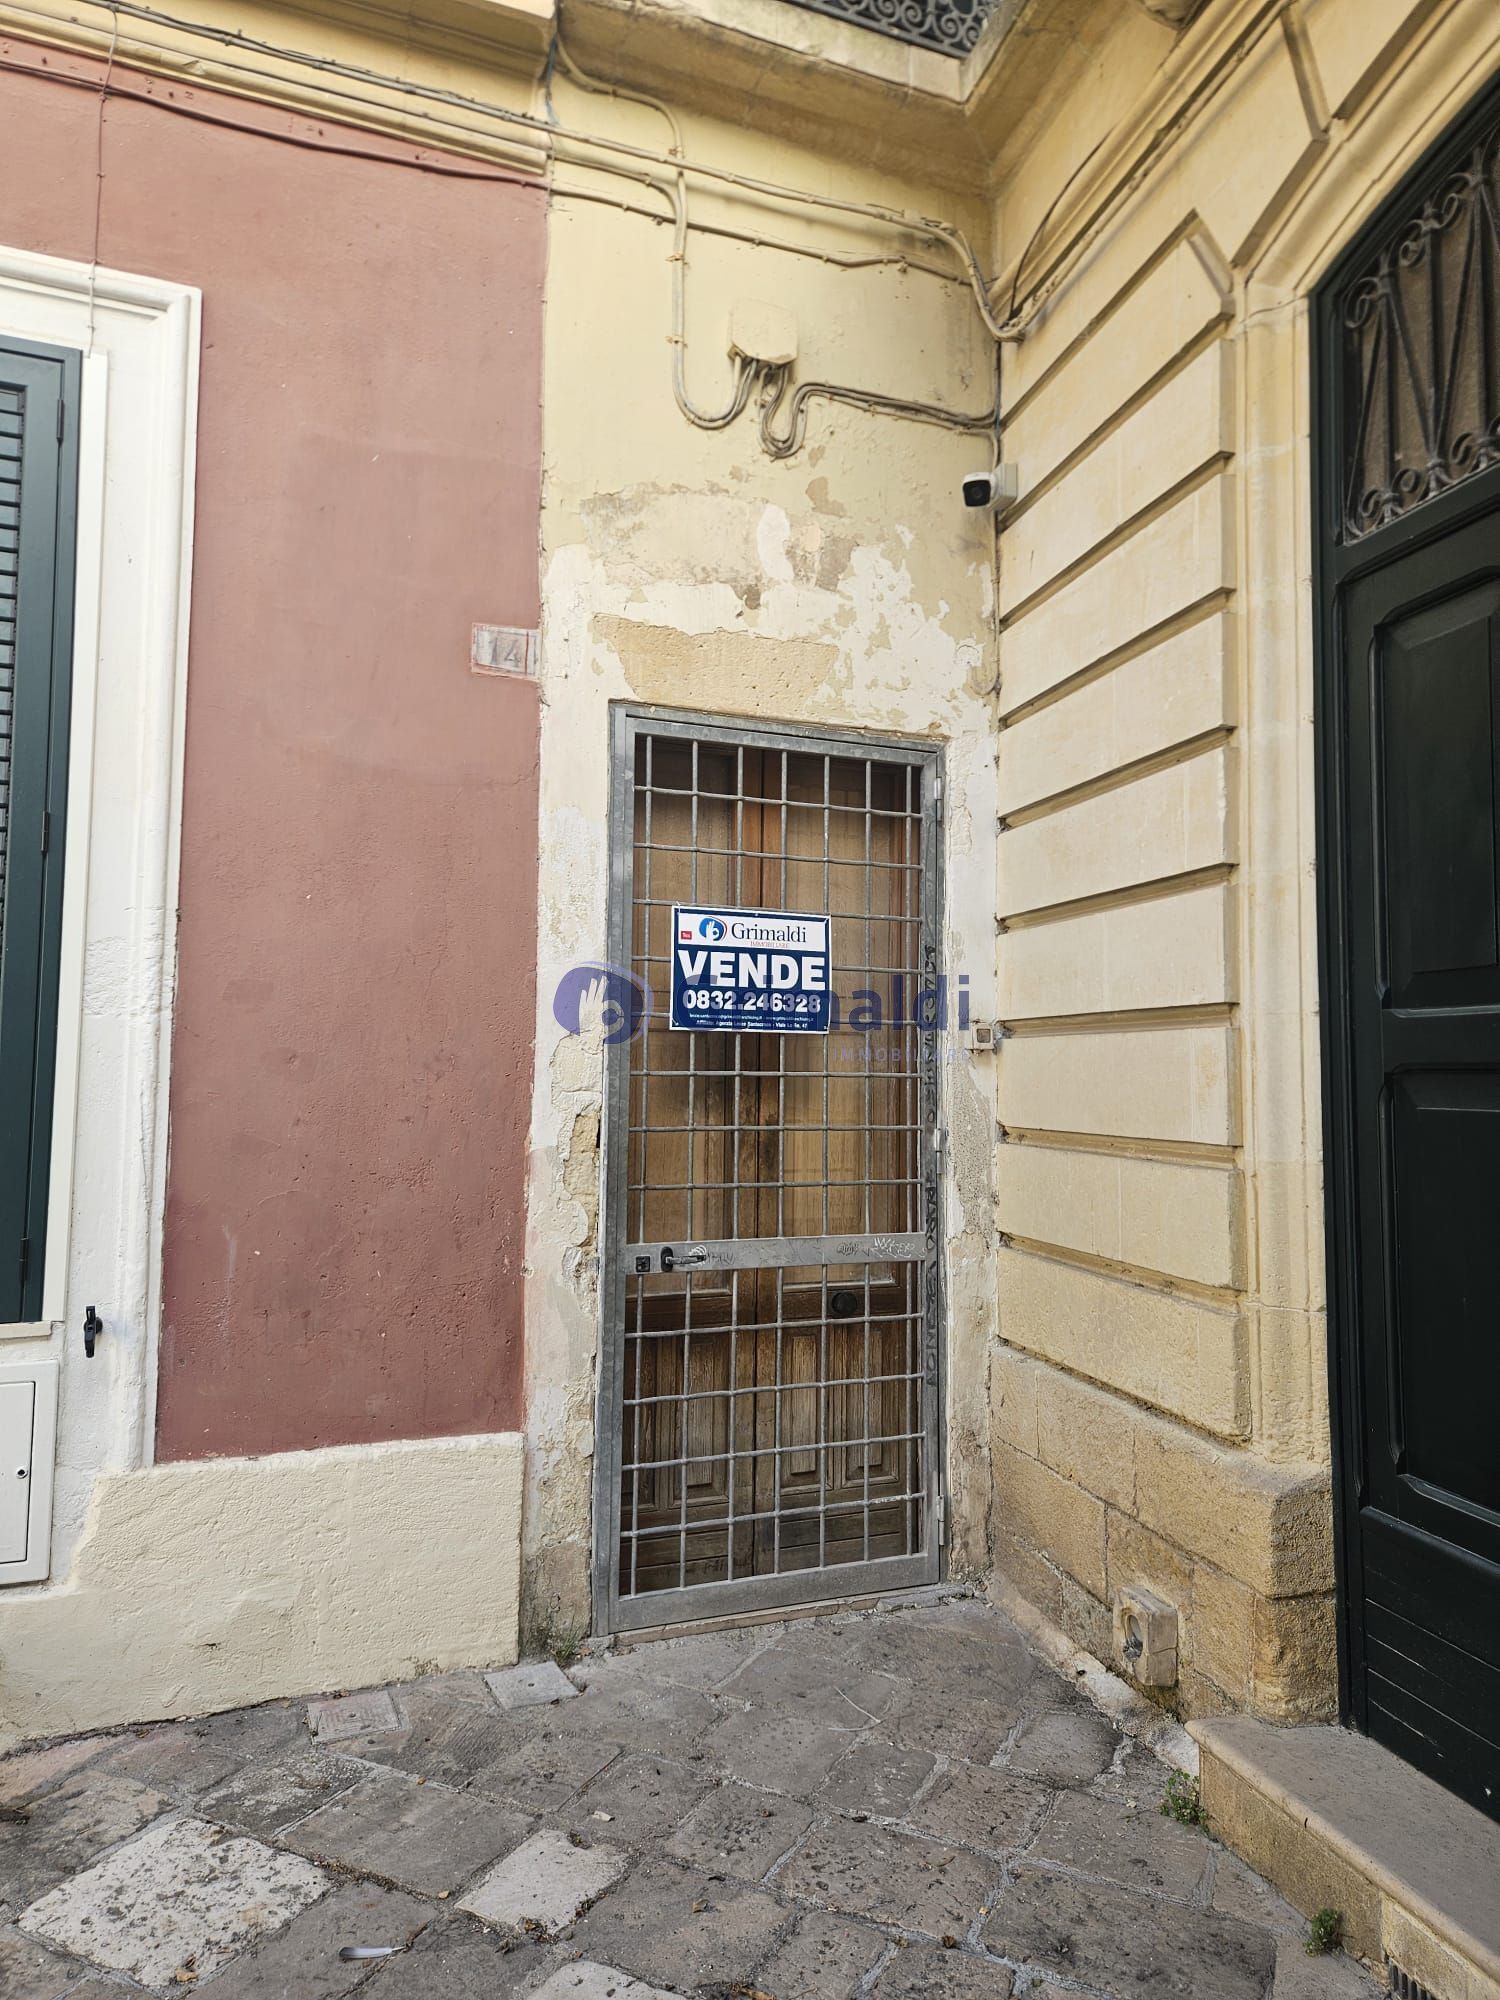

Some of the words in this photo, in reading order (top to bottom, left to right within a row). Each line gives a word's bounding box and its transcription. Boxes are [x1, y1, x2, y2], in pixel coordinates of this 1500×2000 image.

[731, 922, 807, 943] Grimaldi
[677, 950, 826, 991] VENDE
[683, 989, 821, 1013] 0832.246328
